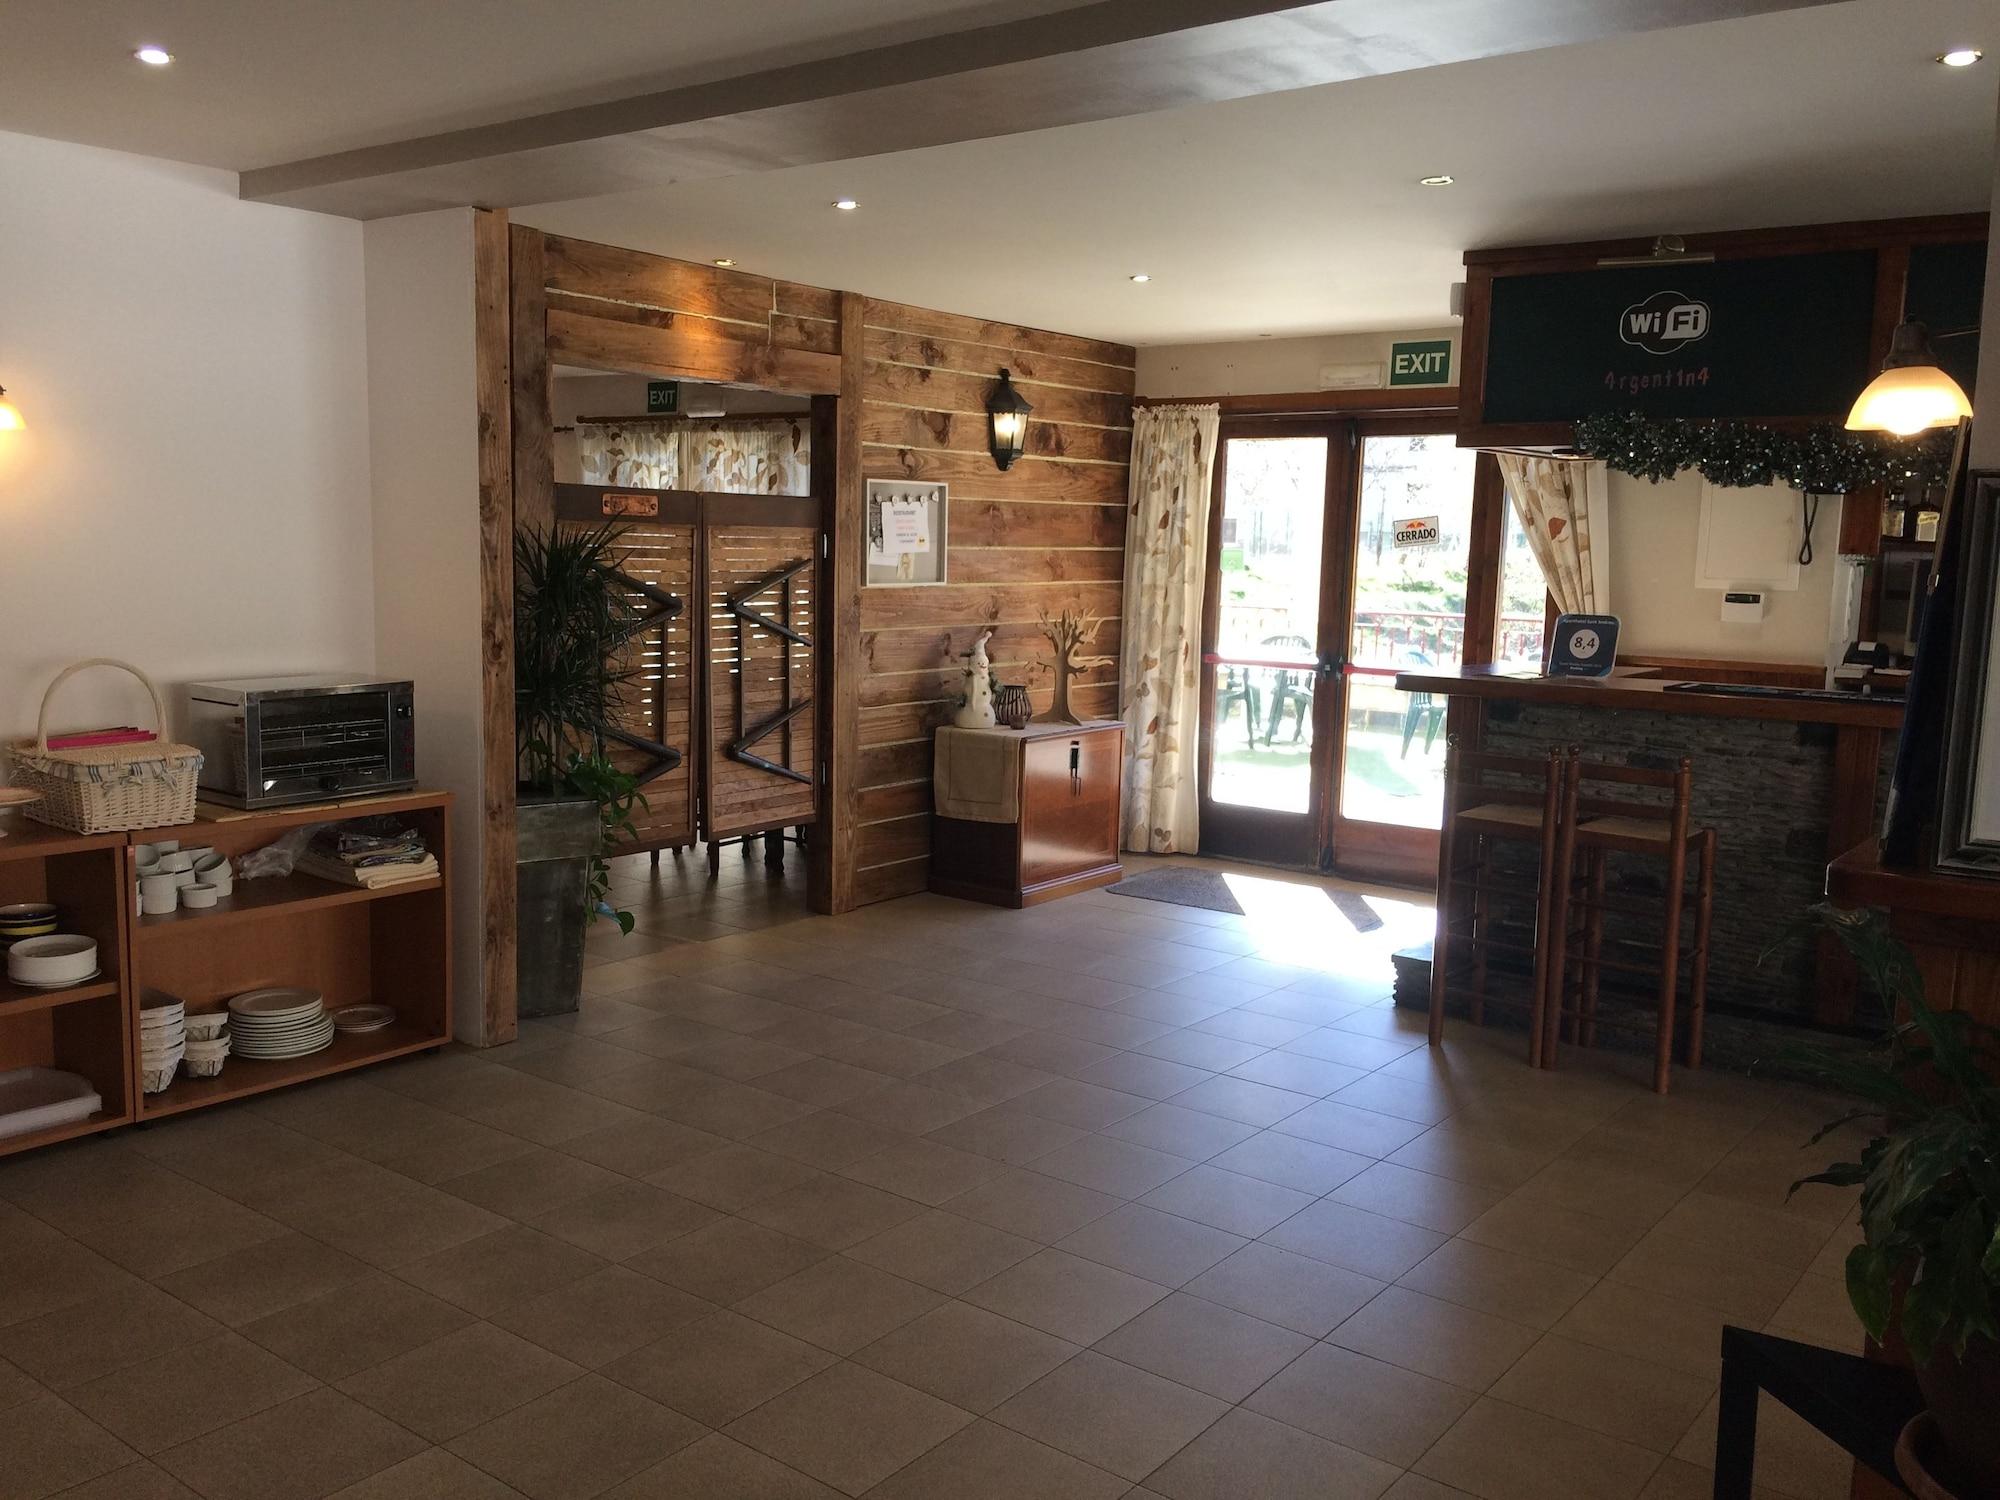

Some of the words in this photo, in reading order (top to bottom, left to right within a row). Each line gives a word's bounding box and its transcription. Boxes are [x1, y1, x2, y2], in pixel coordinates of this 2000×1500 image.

[1395, 352, 1446, 374] EXIT
[649, 390, 675, 405] EXIT
[1396, 528, 1437, 542] CERRADO
[1574, 636, 1596, 650] 8,4
